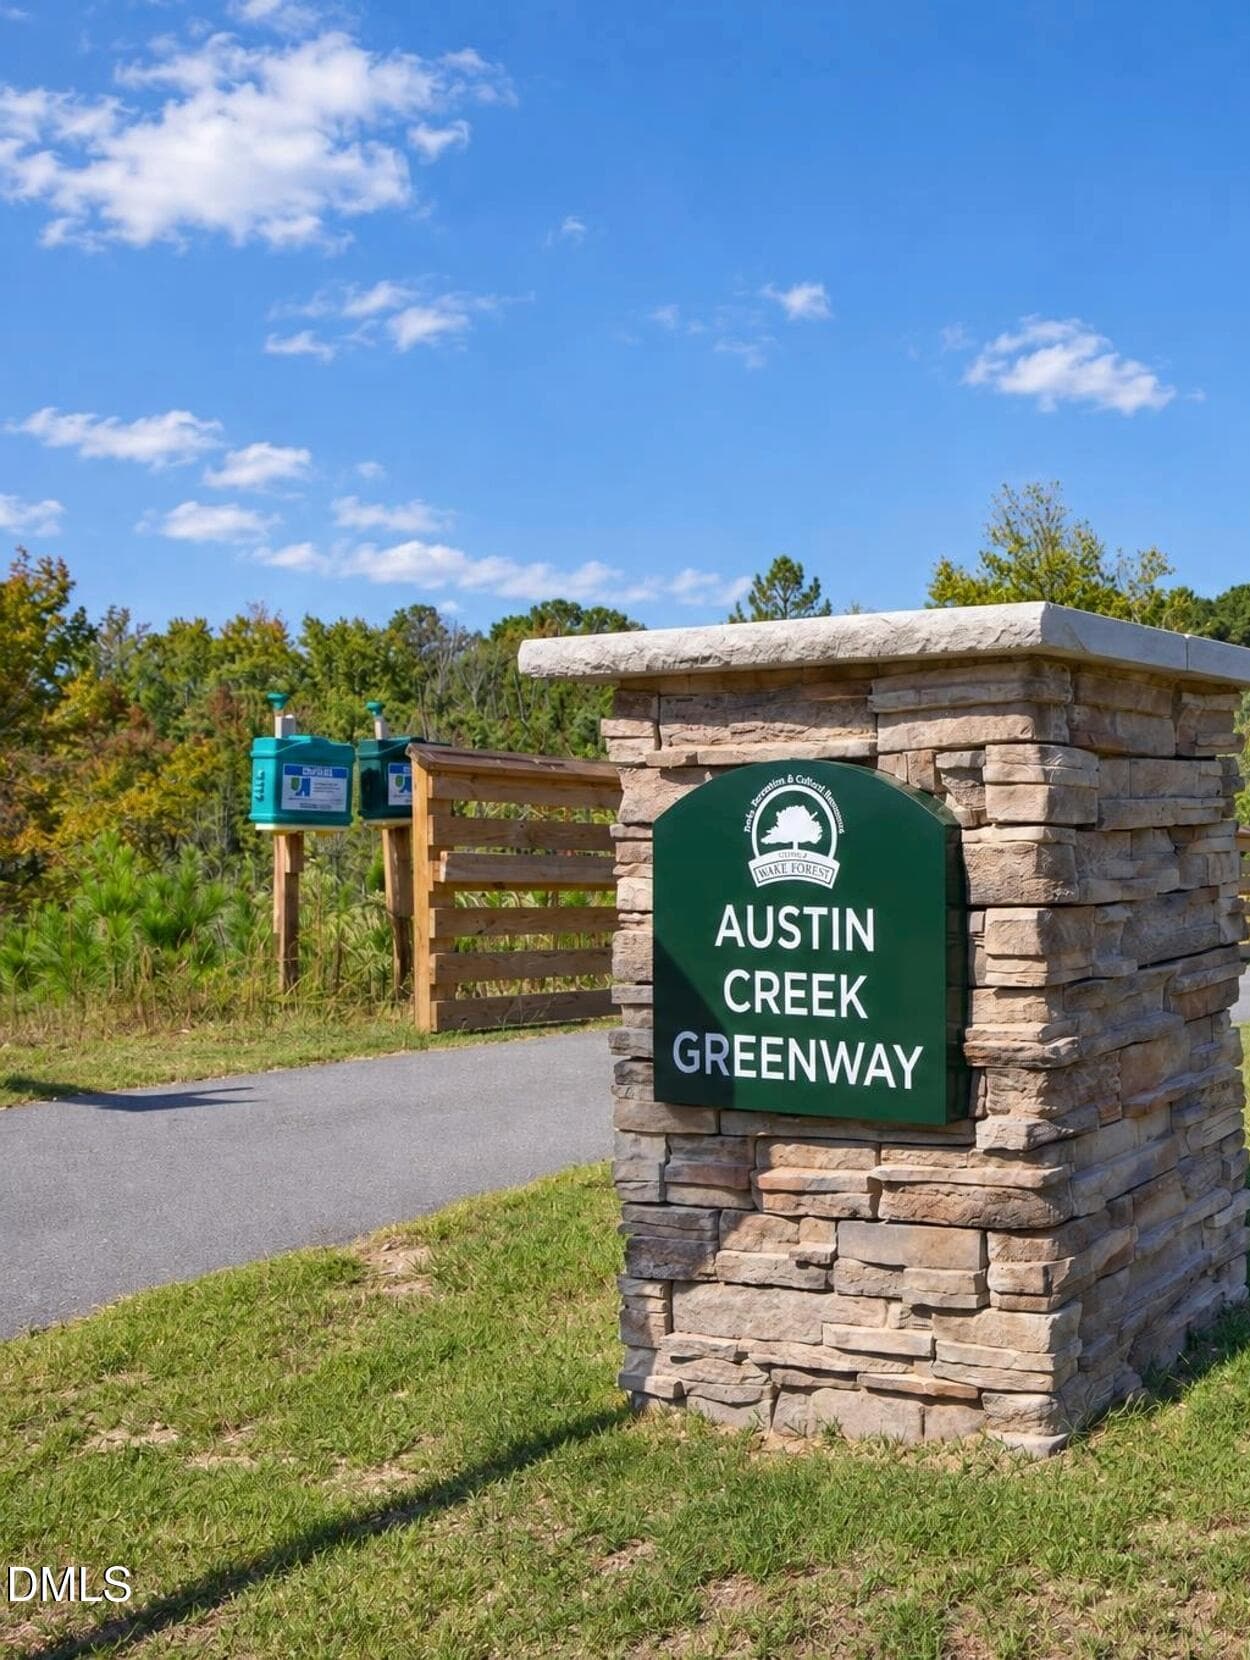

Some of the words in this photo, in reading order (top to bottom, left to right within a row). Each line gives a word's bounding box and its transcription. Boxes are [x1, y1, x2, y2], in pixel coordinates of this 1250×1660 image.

[758, 862, 788, 878] WAKE
[791, 862, 830, 879] FOREST
[715, 904, 875, 951] AUSTIN
[723, 968, 868, 1019] CREEK
[672, 1030, 923, 1090] GREENWAY
